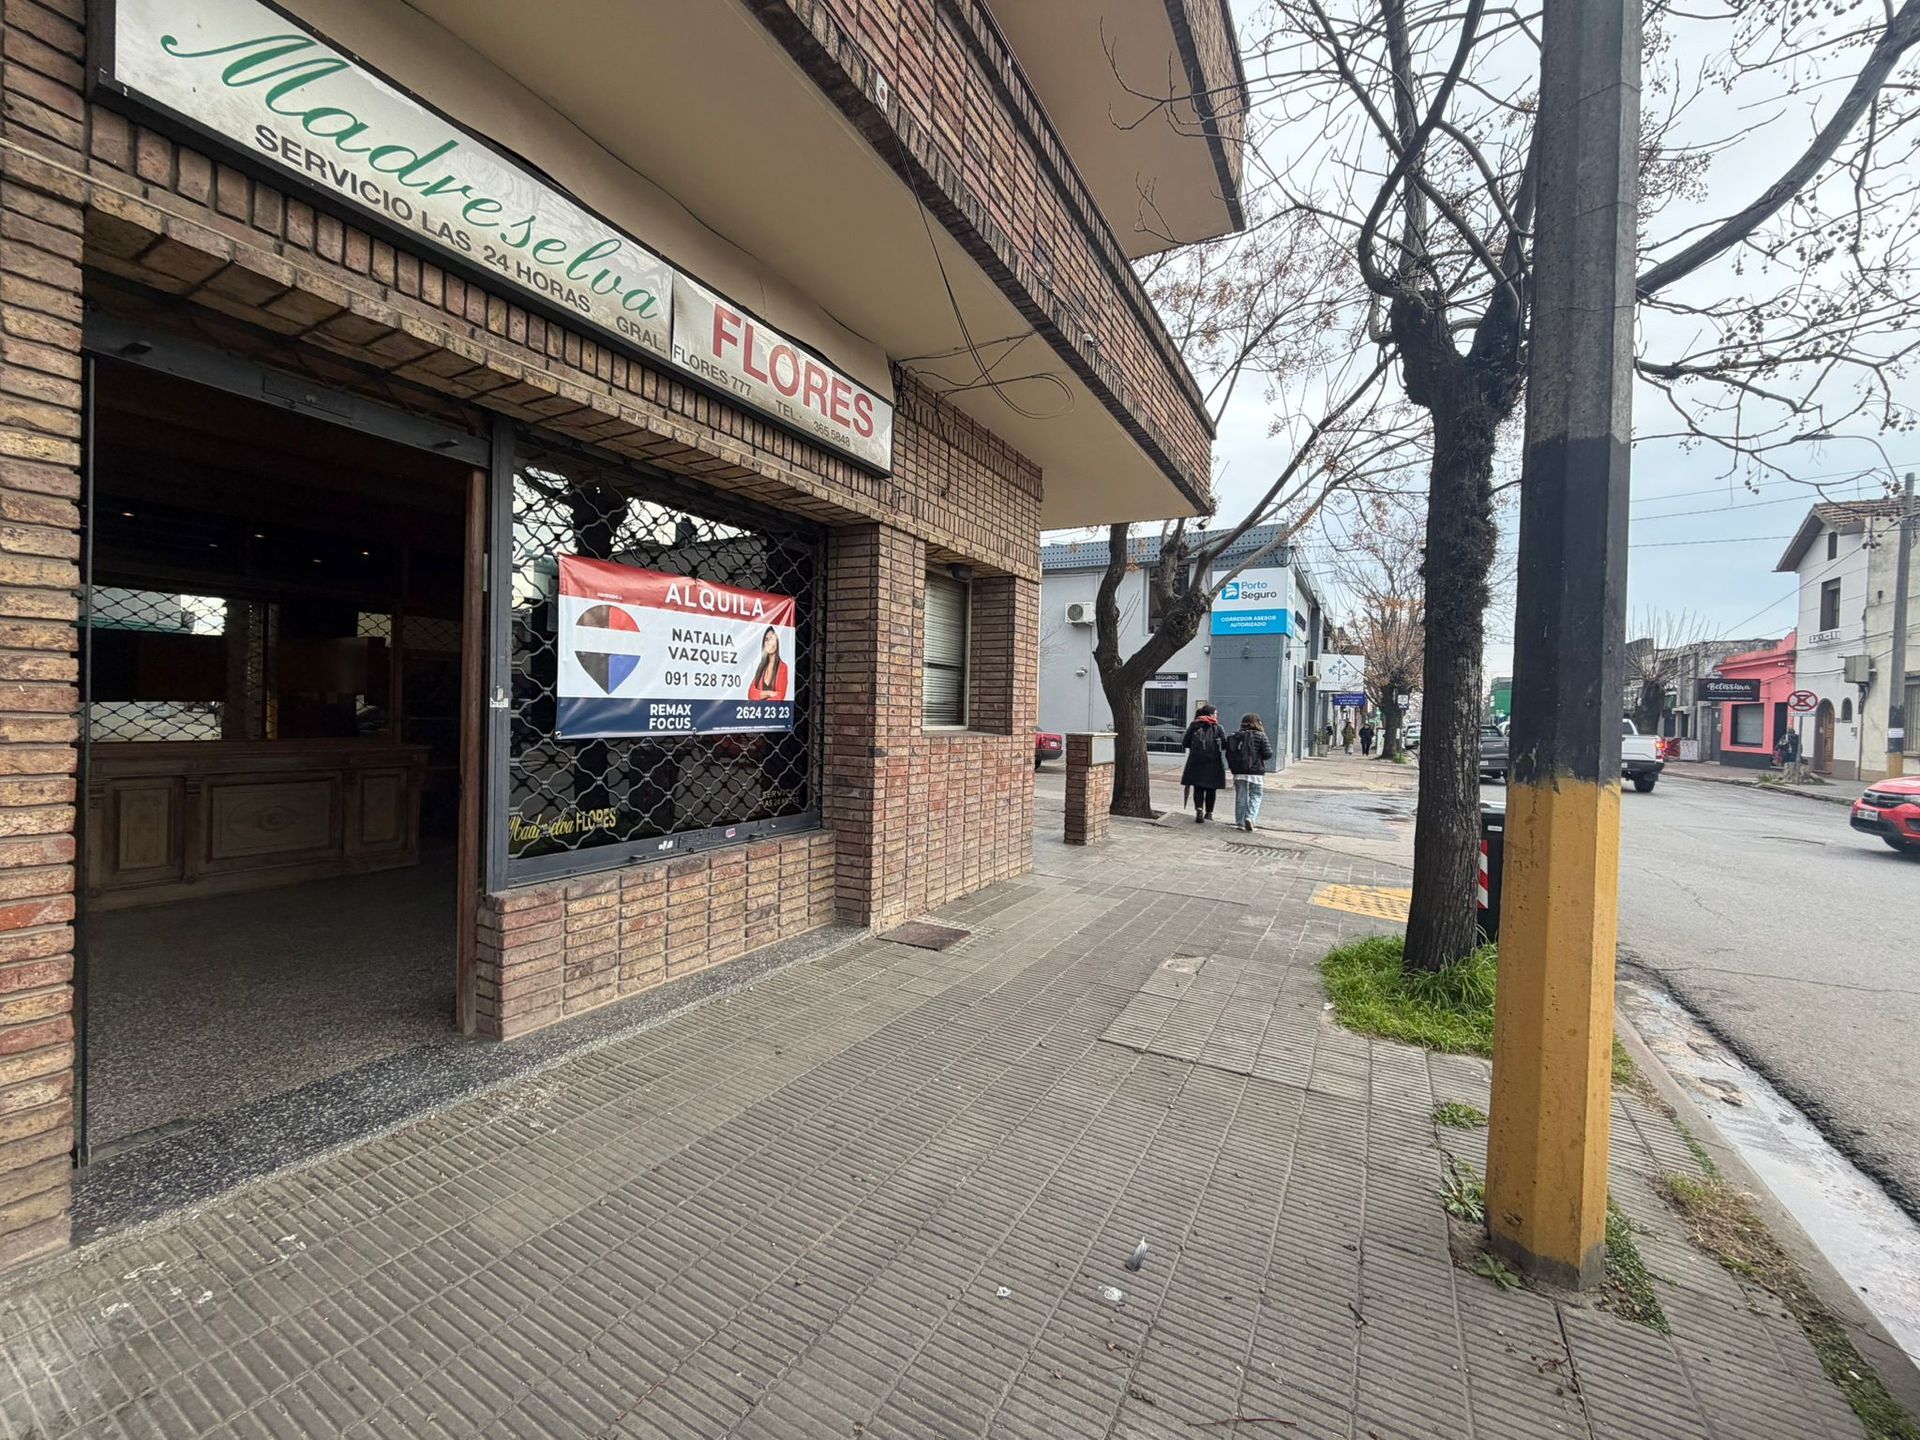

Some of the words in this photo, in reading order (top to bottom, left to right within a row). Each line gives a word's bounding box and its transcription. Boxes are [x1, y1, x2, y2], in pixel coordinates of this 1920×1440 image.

[160, 34, 658, 319] Madreselva
[255, 124, 413, 221] SERVICIO
[422, 211, 472, 252] LAS
[483, 245, 509, 271] 24
[516, 260, 591, 313] HORAS
[712, 302, 874, 438] FLORES
[616, 316, 666, 353] GRAL.
[673, 344, 728, 384] FLORES
[731, 375, 752, 396] 777
[813, 420, 829, 437] 365
[831, 430, 851, 447] 5848
[1241, 582, 1267, 590] Porto
[1241, 591, 1277, 600] Seguro
[664, 583, 764, 617] ALQUILA
[672, 628, 735, 648] NATALIA
[668, 646, 739, 665] VAZQUEZ
[665, 671, 688, 686] 091
[694, 672, 717, 687] 528
[721, 674, 742, 688] 730
[650, 704, 692, 716] REMAX
[736, 706, 761, 719] 2624
[764, 706, 776, 719] 23
[778, 707, 790, 719] 23
[649, 717, 691, 730] FOCUS
